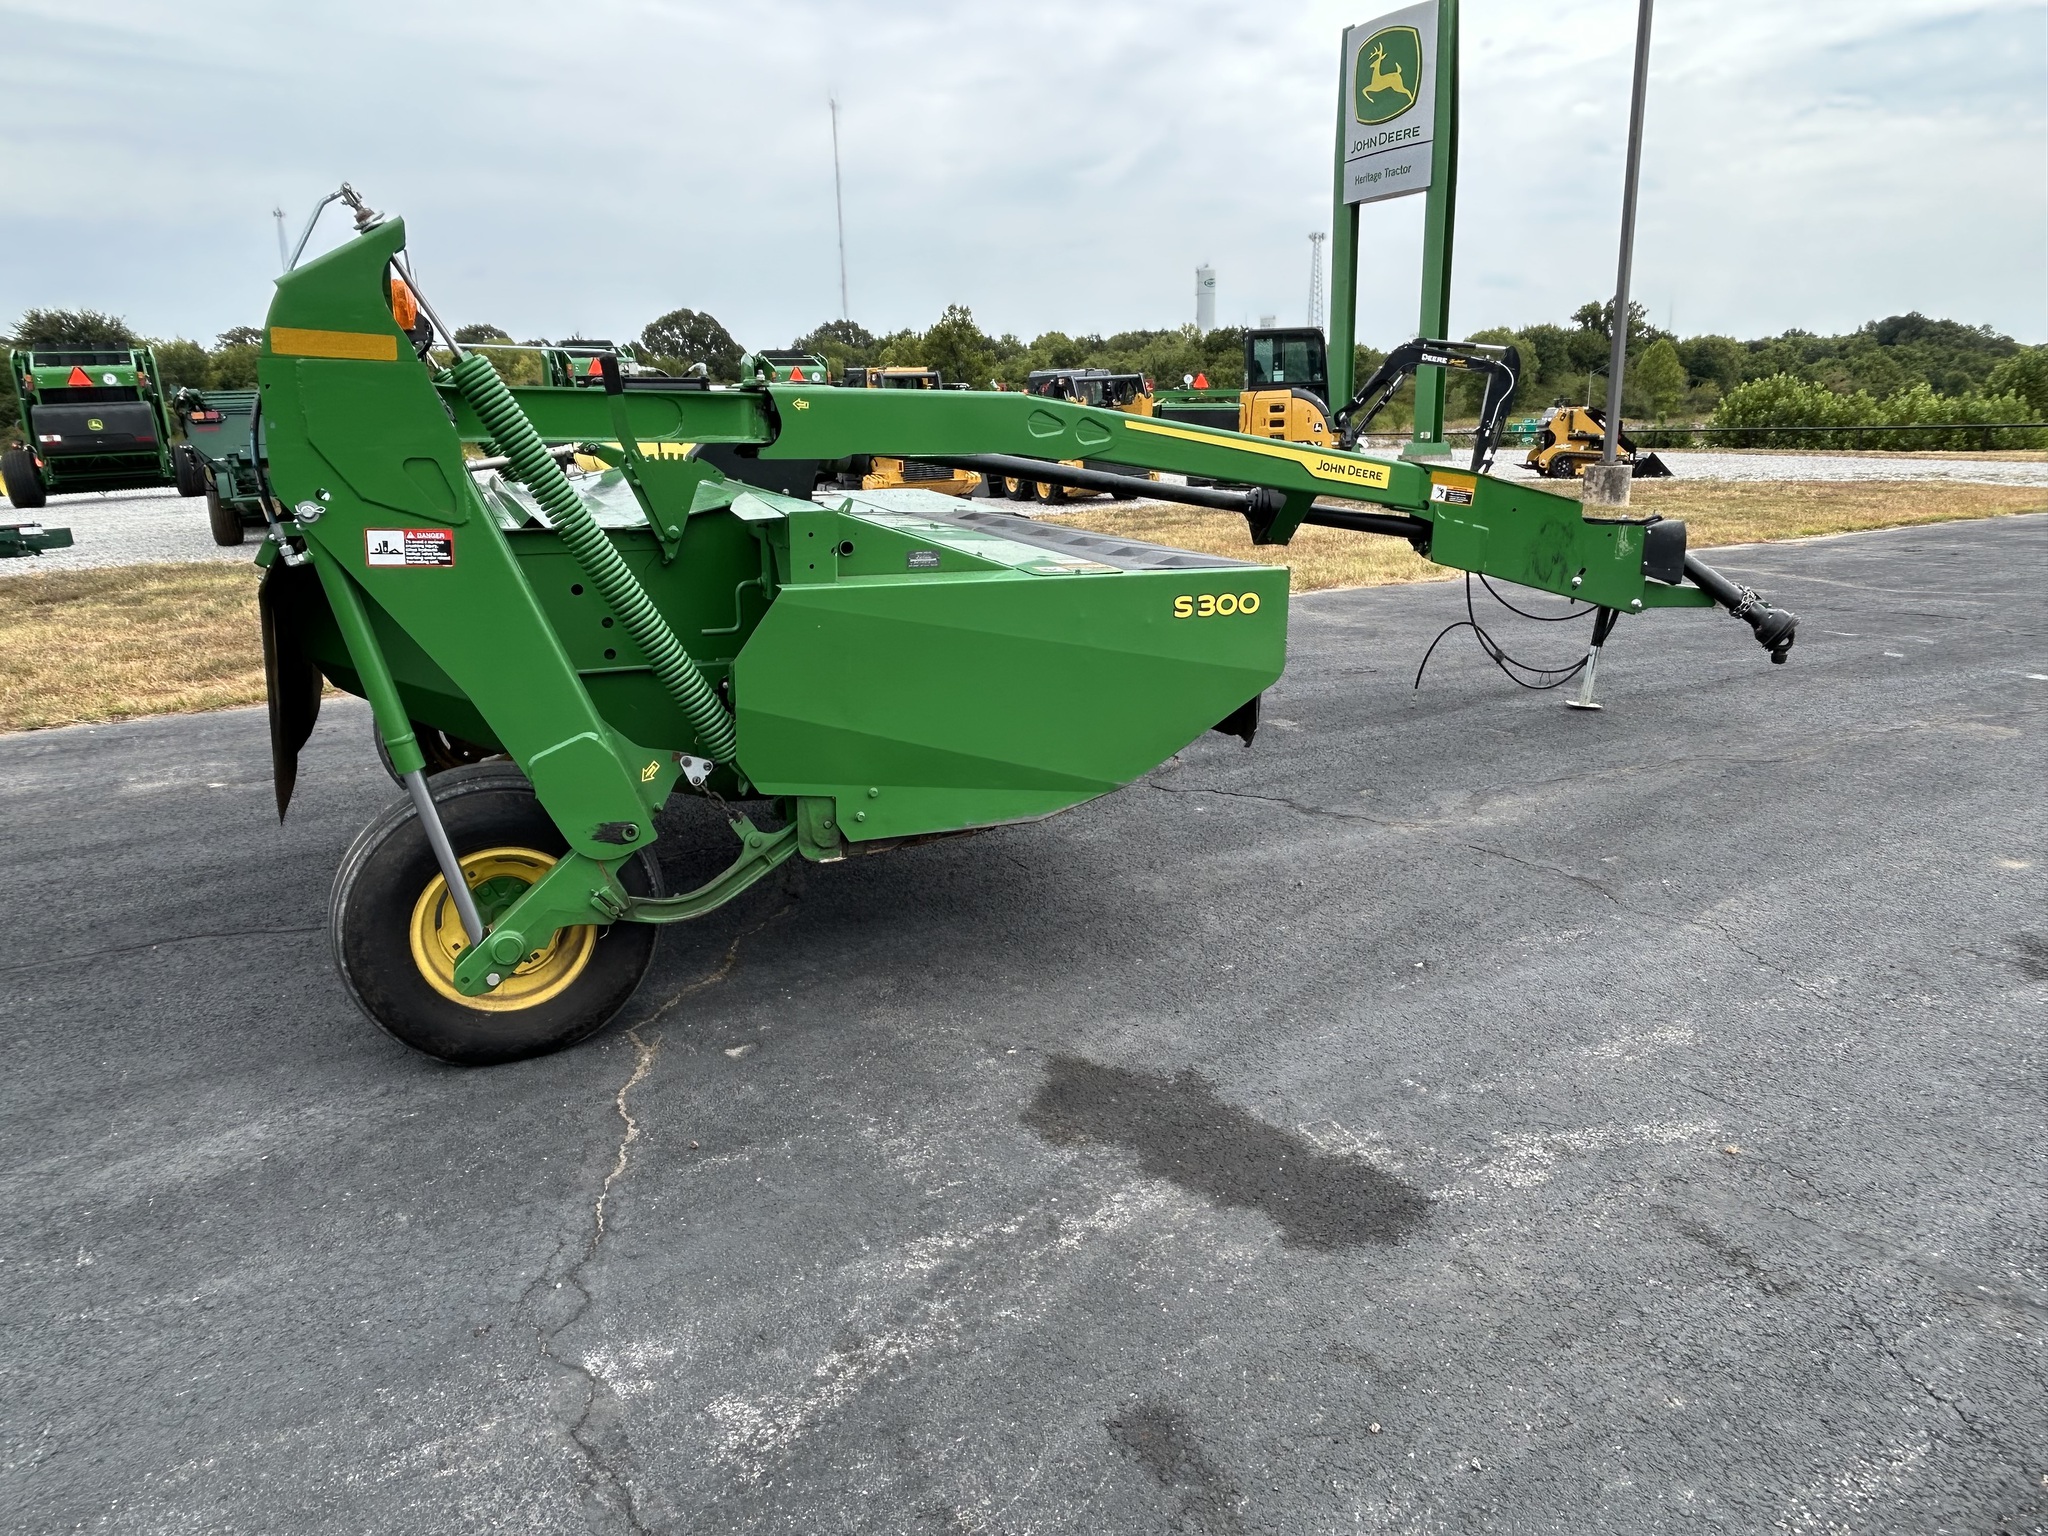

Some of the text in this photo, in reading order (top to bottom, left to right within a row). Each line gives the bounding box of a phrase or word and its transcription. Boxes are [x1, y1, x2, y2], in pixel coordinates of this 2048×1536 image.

[1351, 126, 1420, 153] JOHN DEERE
[1355, 165, 1412, 185] Heritage Tractor
[1316, 459, 1383, 481] JOHN DEERE
